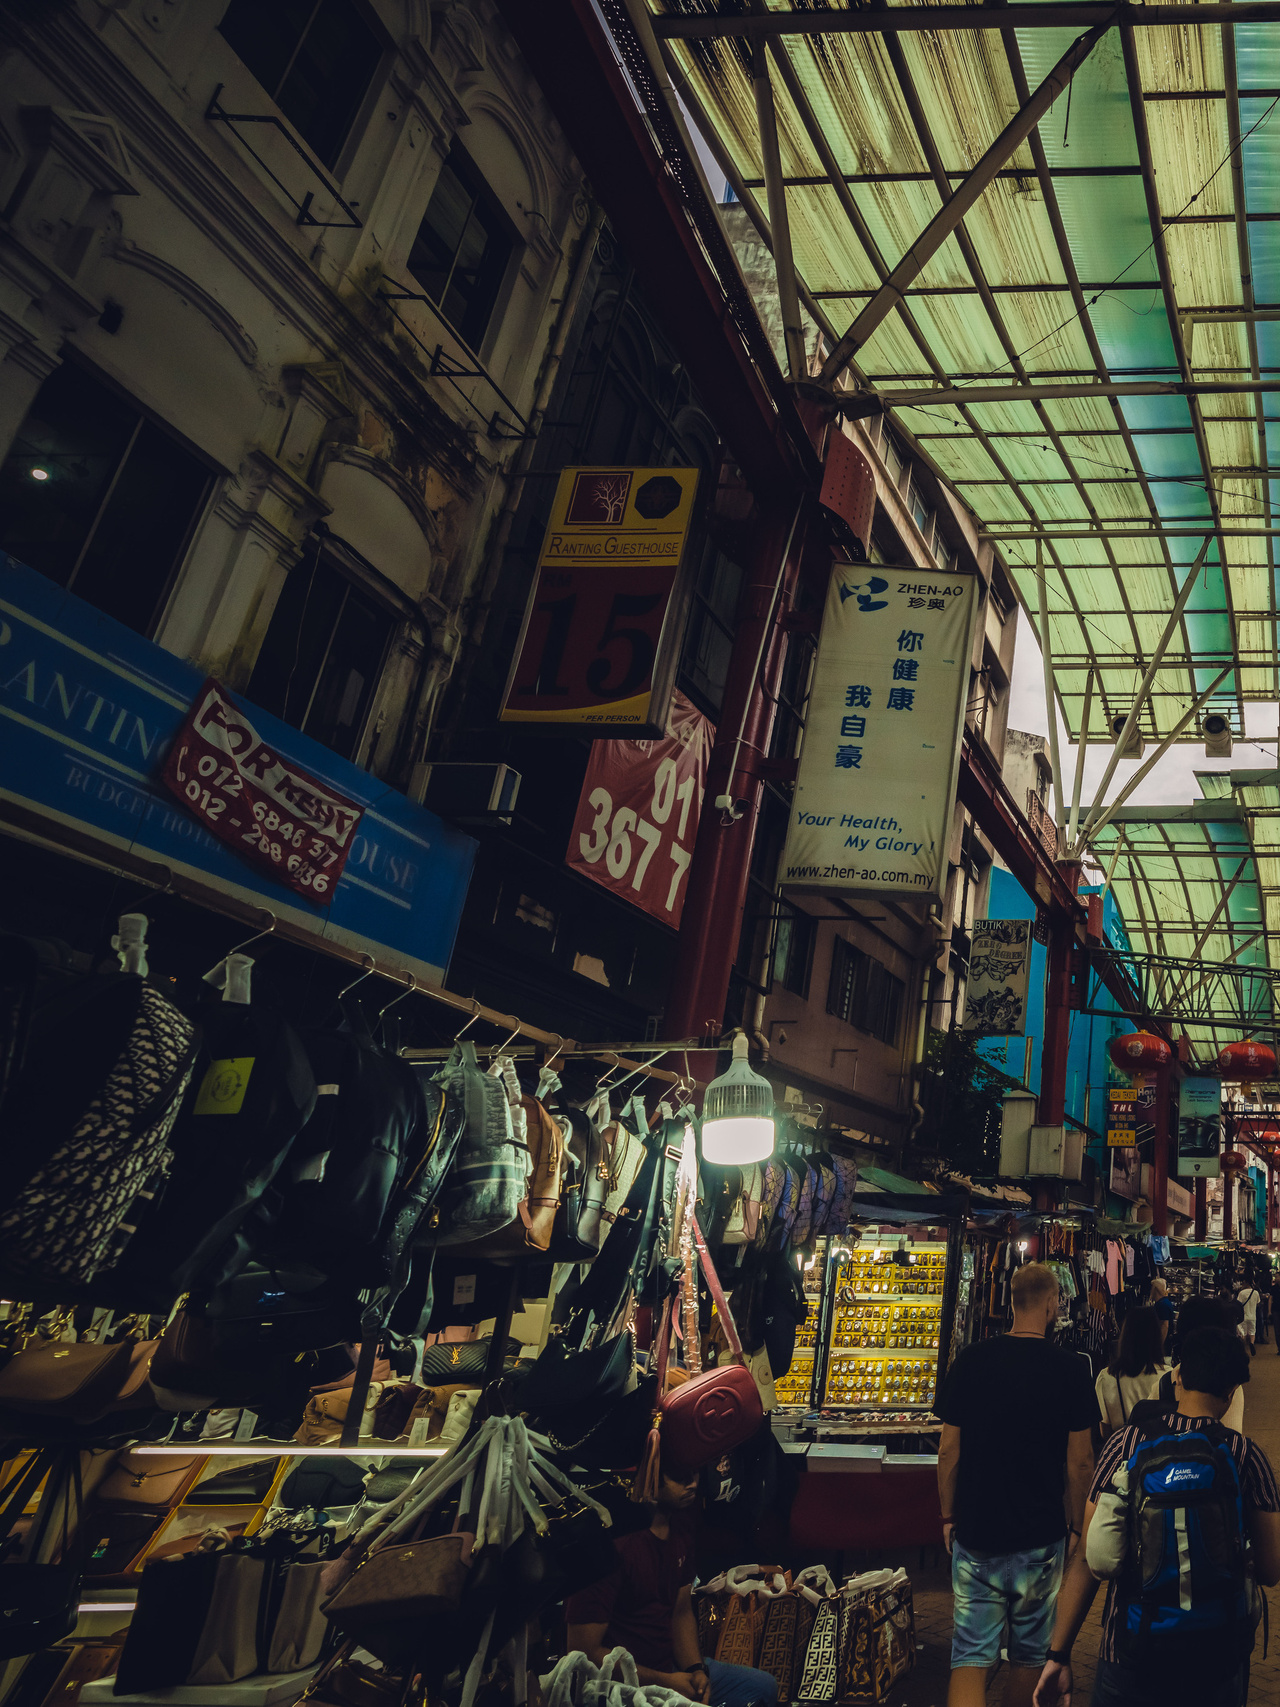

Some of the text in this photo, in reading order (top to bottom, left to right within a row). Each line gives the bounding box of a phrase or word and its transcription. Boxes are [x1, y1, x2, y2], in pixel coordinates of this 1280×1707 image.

[897, 583, 963, 597] ZHEN-AO
[518, 592, 664, 698] 15
[887, 629, 924, 711] 你健康
[200, 700, 279, 780] FOR
[834, 685, 872, 769] 我自豪
[185, 780, 227, 822] 012
[198, 756, 243, 798] 012
[253, 801, 307, 848] 6846
[579, 787, 662, 892] 367
[797, 812, 903, 833] Your Health,
[844, 835, 869, 851] My
[875, 837, 923, 855] Glory
[786, 864, 934, 890] www.zhen-ao.com.my
[975, 921, 1003, 930] BUTIK
[977, 940, 1003, 949] ZERO
[1173, 1473, 1200, 1481] MOUNTAIN
